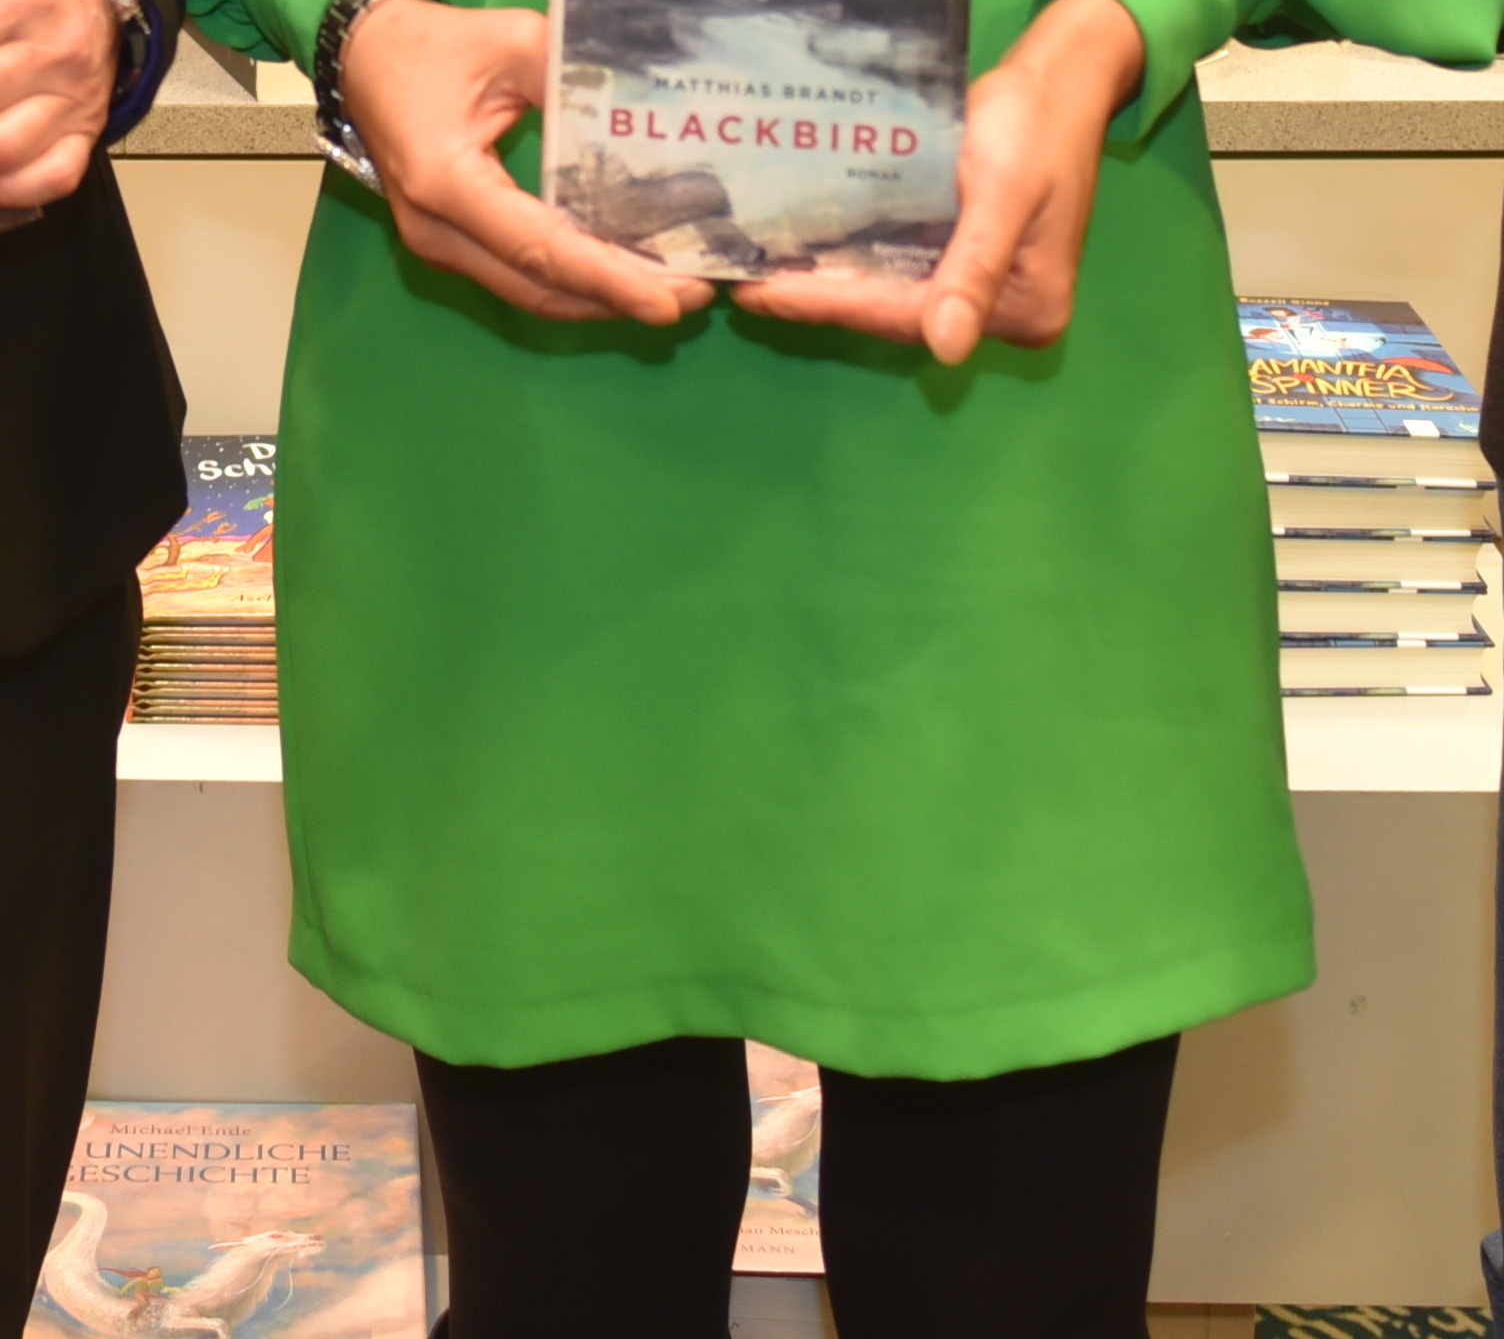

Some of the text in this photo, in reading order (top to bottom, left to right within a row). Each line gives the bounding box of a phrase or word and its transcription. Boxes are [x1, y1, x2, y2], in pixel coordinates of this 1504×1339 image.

[654, 77, 878, 105] MATTHIAS BRANDT
[609, 107, 920, 156] BLACKBIRD
[1249, 358, 1434, 391] AMANTHA
[1249, 375, 1454, 402] SPINNER
[1388, 402, 1416, 411] und
[110, 1124, 252, 1136] Michael Ende
[85, 1141, 351, 1161] UNENDLICHE
[740, 1244, 795, 1254] MANN
